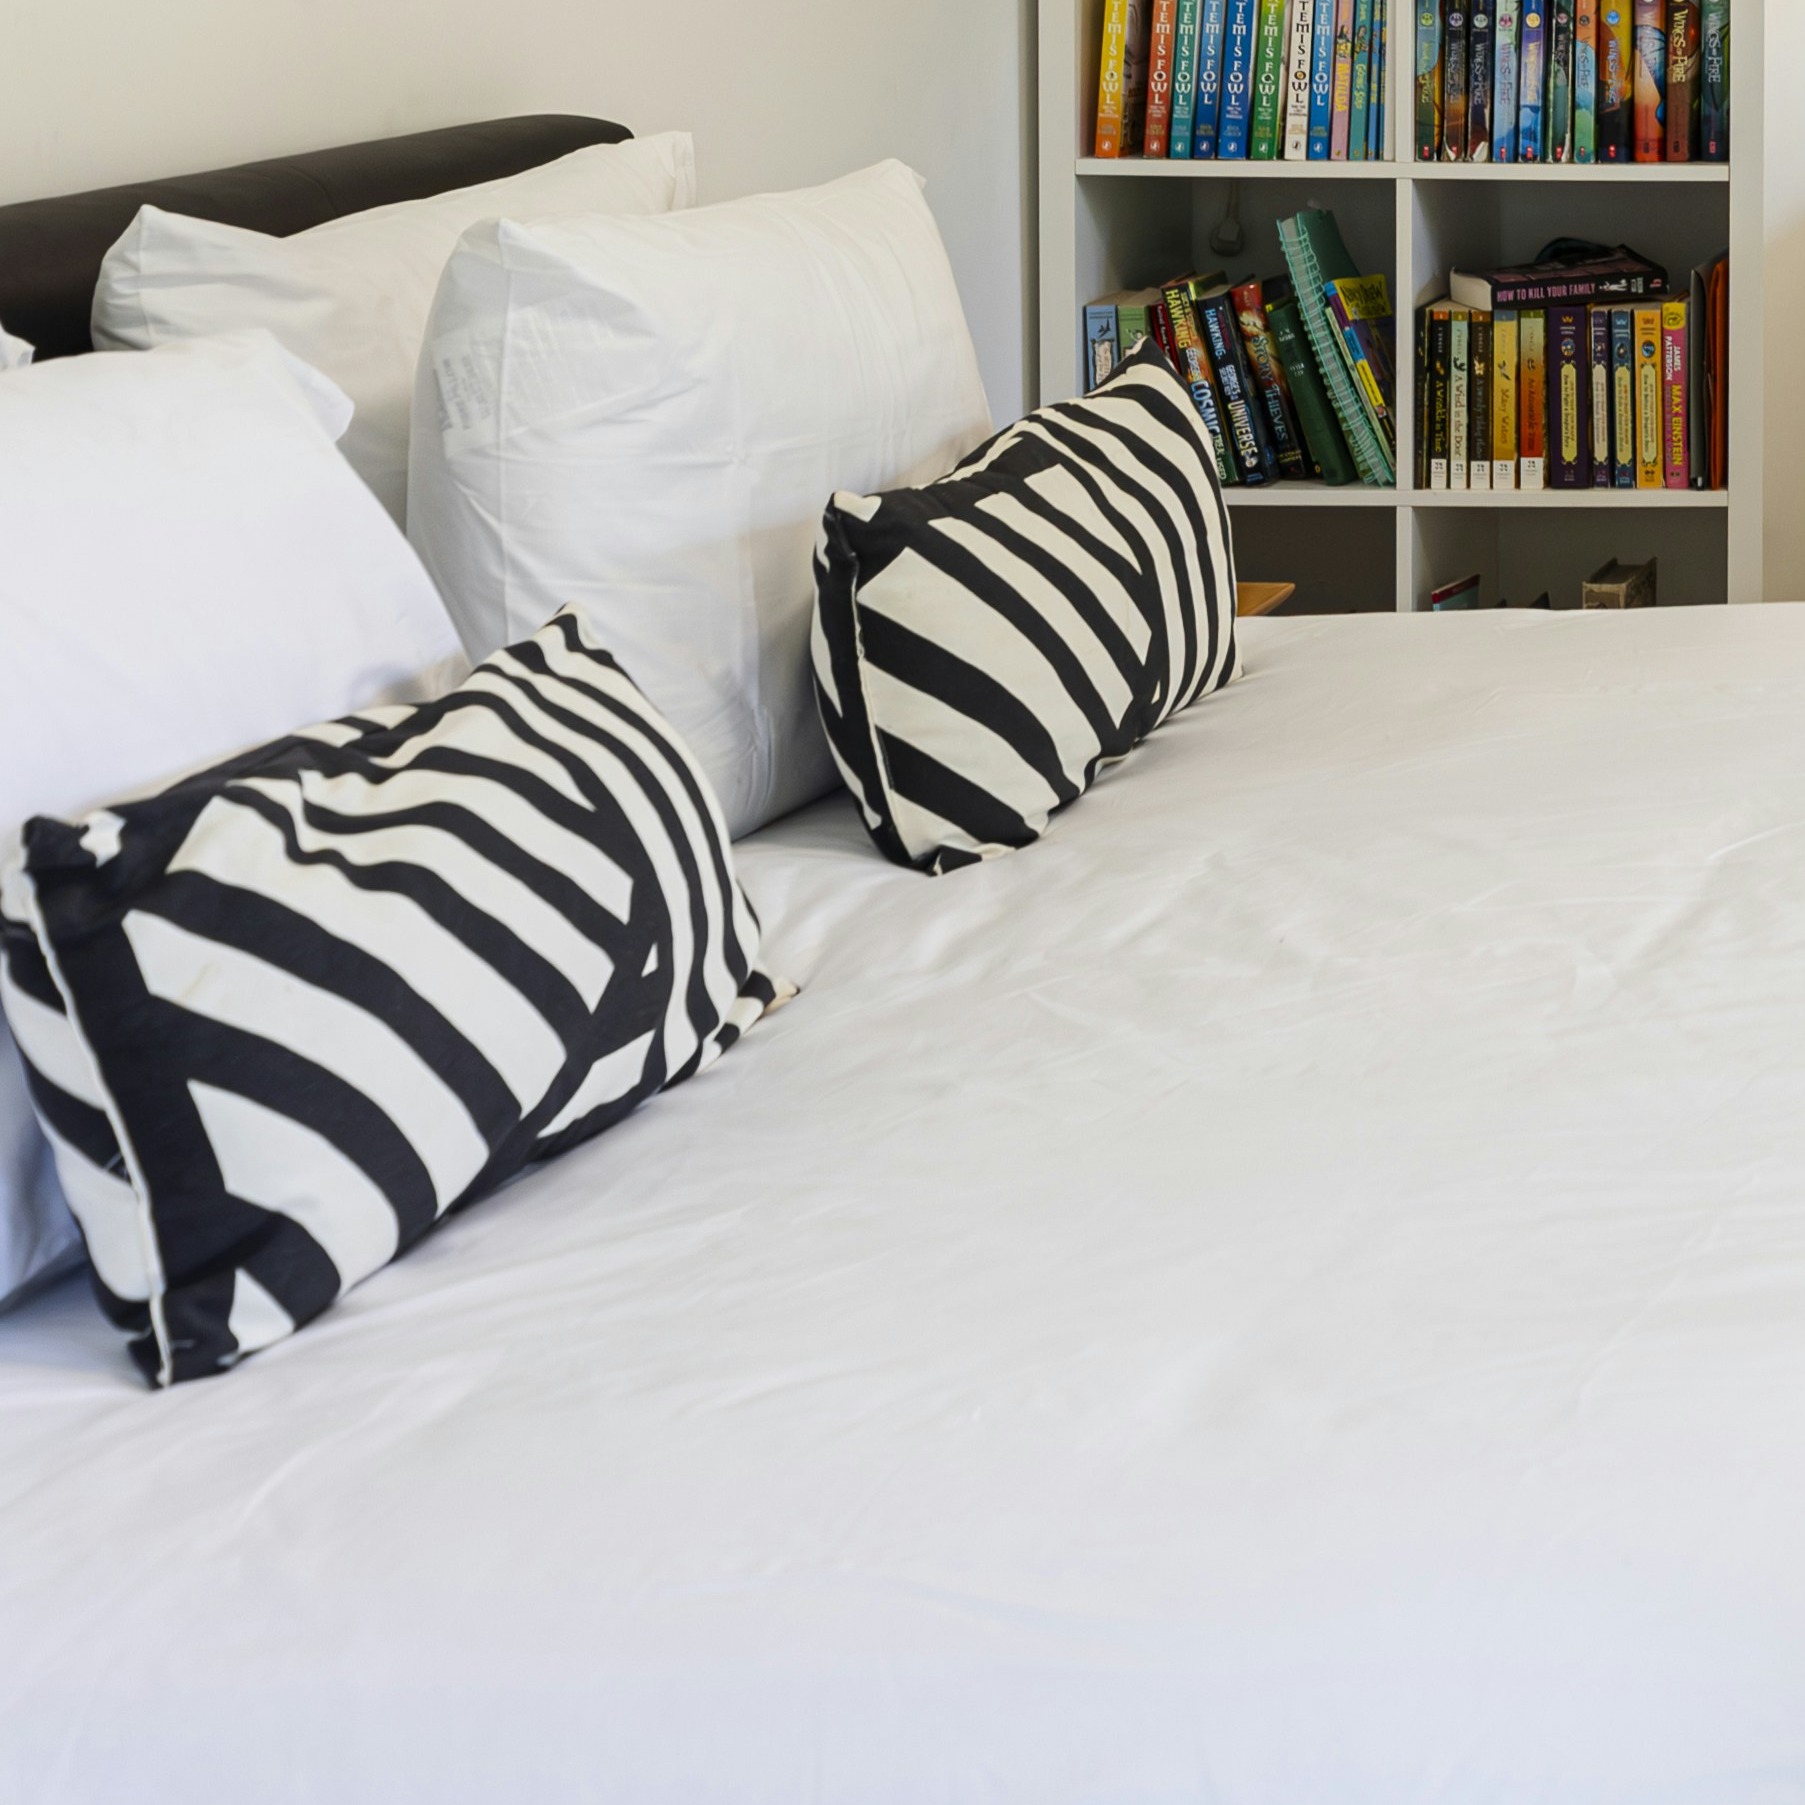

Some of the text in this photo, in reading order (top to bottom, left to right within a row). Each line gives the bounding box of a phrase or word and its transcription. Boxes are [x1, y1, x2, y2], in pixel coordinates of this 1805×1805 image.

[1671, 8, 1689, 83] WINGS FIRE
[1102, 59, 1118, 104] FOWL
[1151, 59, 1167, 104] FOWL
[1175, 60, 1191, 105] FOWL
[1200, 59, 1217, 105] FOWL
[1227, 61, 1244, 106] FOWL
[1259, 62, 1275, 107] FOWL
[1292, 60, 1308, 104] FOWL
[1312, 61, 1329, 106] FOWL
[1707, 56, 1722, 83] FIRE
[1497, 282, 1596, 302] HOW TO KILL YOUR FAMILY
[1166, 289, 1192, 349] HAWKING
[1205, 308, 1227, 357] HAWKING
[1250, 334, 1274, 382] STORY
[1664, 335, 1674, 380] PATTERSON
[1673, 345, 1682, 372] JAMES
[1264, 382, 1289, 441] THIEVES
[1455, 384, 1465, 408] Wind
[1228, 399, 1259, 457] UNIVERSE
[1435, 430, 1443, 452] Time
[1455, 435, 1464, 456] Door
[1671, 384, 1683, 465] MAX EINSTEIN
